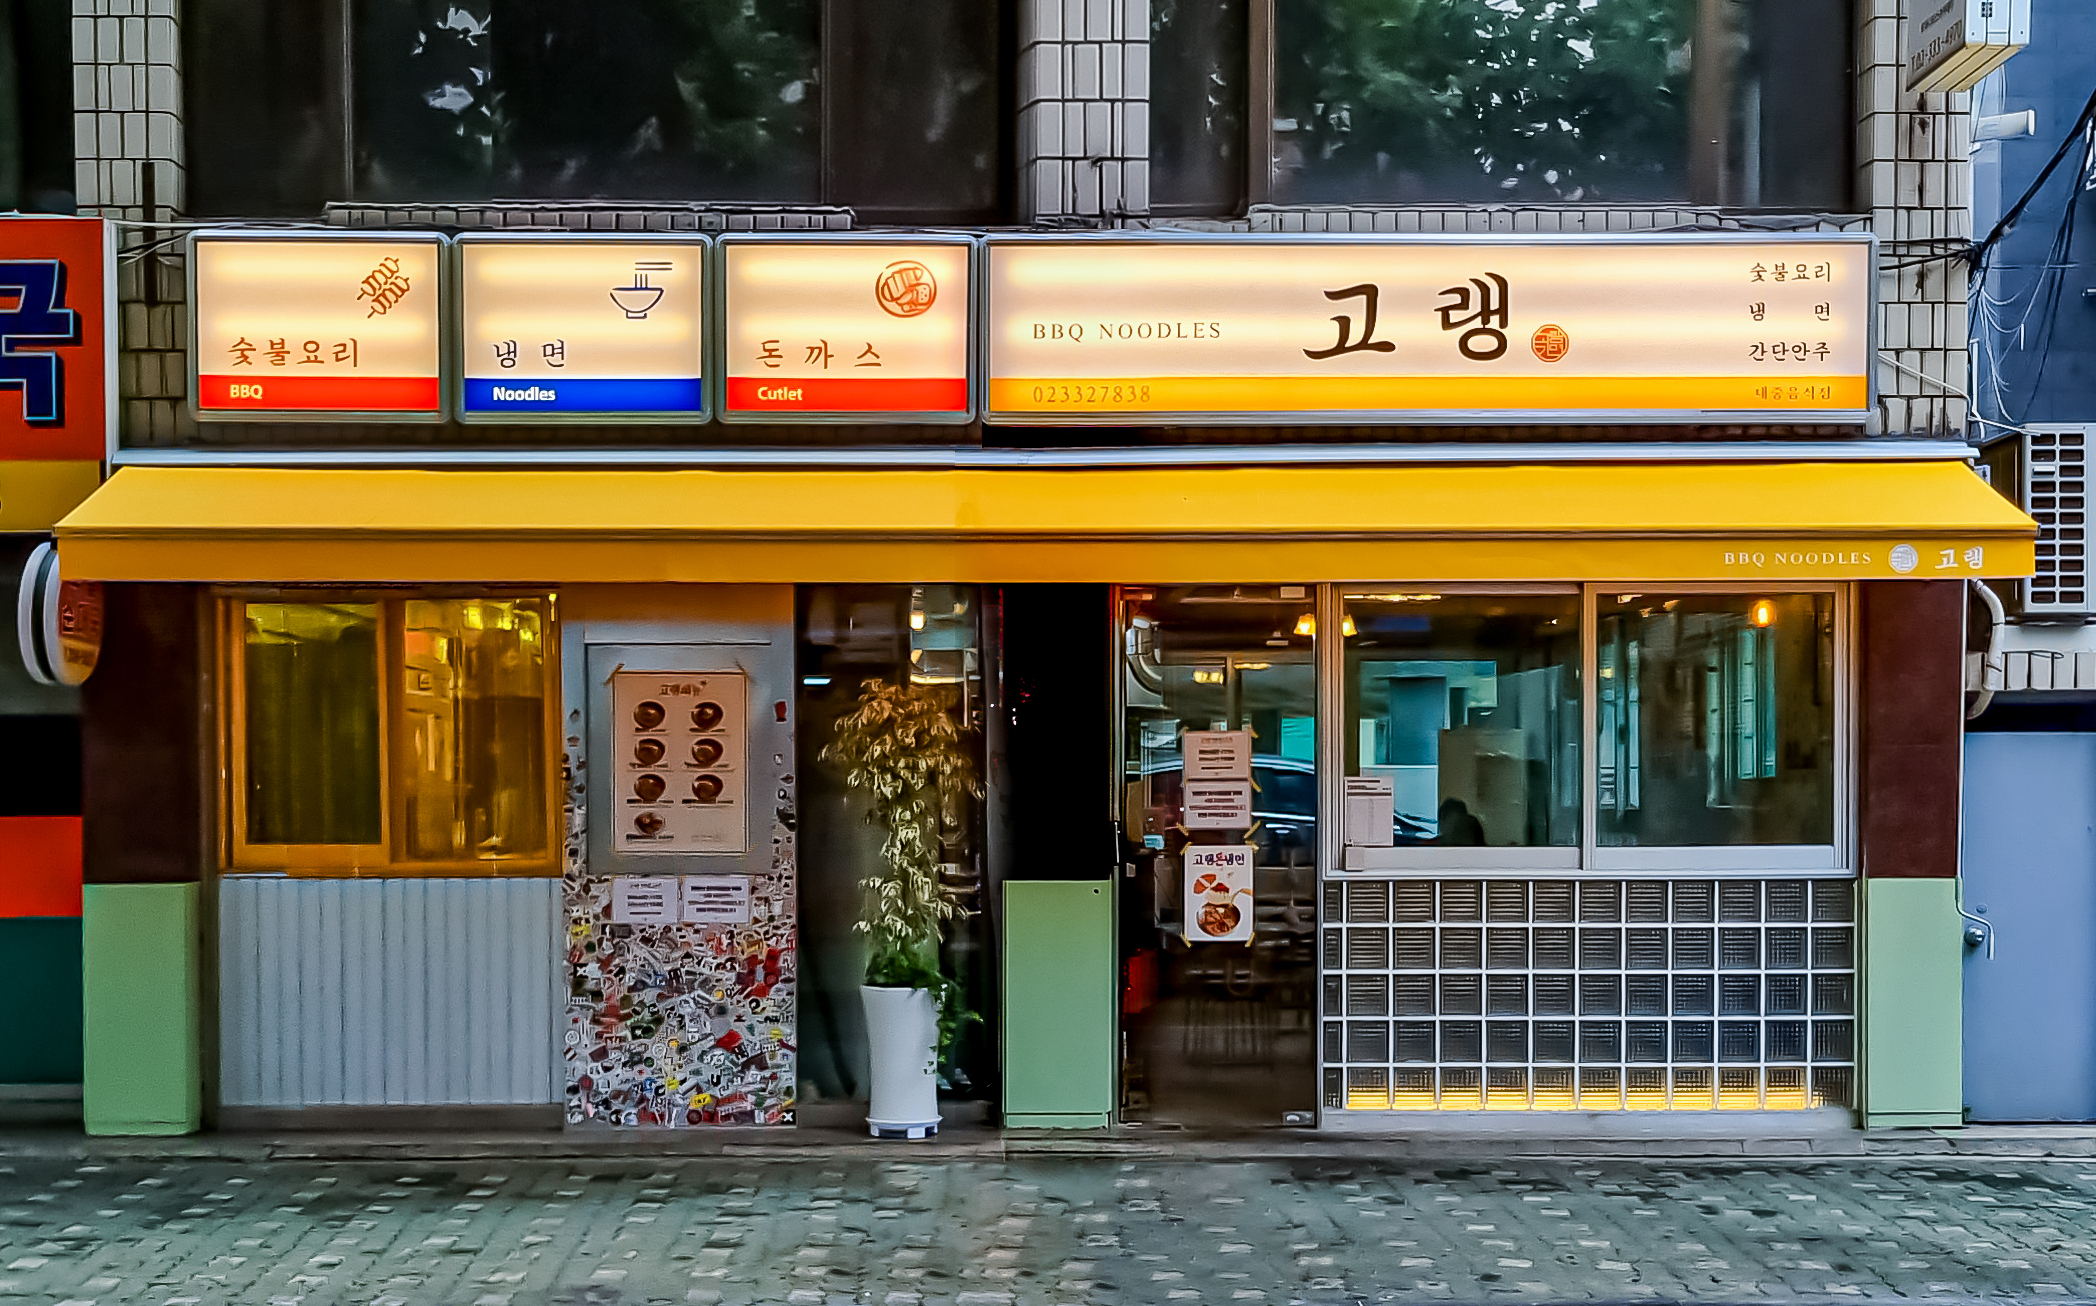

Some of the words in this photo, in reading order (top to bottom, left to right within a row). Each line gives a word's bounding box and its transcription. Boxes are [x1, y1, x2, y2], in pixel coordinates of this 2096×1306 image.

[1749, 261, 1831, 282] 숯불요리
[1302, 271, 1509, 361] 고랭
[1032, 322, 1085, 343] BBQ
[1098, 321, 1221, 340] NOODLES
[227, 337, 359, 367] 숯불요리
[1748, 341, 1831, 362] 간단안주
[230, 384, 263, 400] BBQ
[493, 386, 556, 401] Noodles
[757, 386, 803, 401] Cutlet
[1032, 384, 1151, 403] 023327838
[1724, 552, 1765, 568] BBQ
[1774, 551, 1872, 565] NOODLES
[1934, 545, 1984, 570] 고랭
